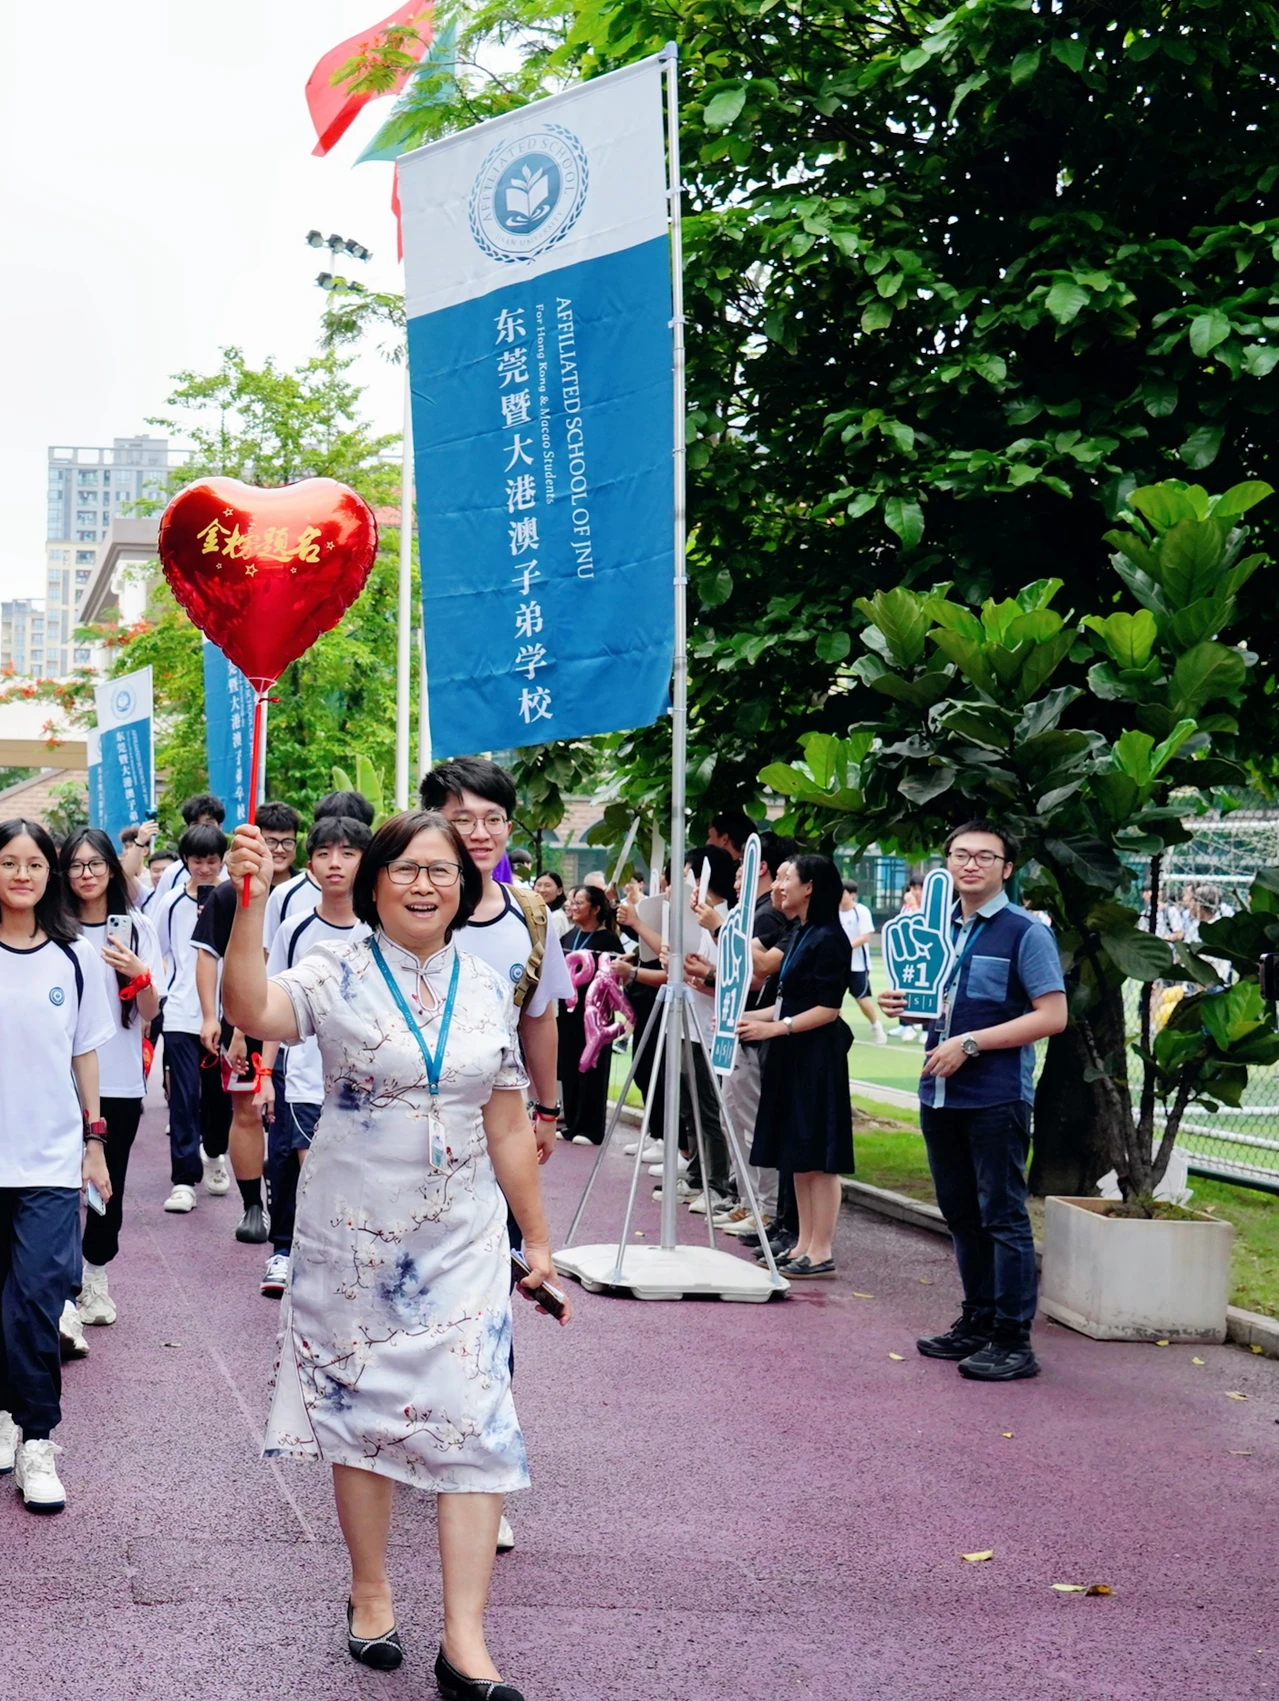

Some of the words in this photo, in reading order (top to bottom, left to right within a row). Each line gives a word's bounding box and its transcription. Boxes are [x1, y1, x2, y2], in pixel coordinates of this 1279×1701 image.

[481, 138, 537, 222] AFFILIATED
[542, 138, 577, 195] SCHOOL
[535, 303, 545, 324] For
[536, 326, 546, 359] Hong
[556, 297, 582, 414] AFFILIATED
[538, 361, 548, 393] Kong
[540, 395, 550, 406] &
[540, 408, 552, 449] Macao
[543, 451, 557, 505] Students
[566, 417, 589, 506] SCHOOL
[493, 307, 554, 724] 东莞暨大港澳子弟学校
[571, 508, 591, 537] OF
[197, 518, 322, 563] 金榜题名
[570, 541, 595, 579] JNU
[902, 962, 930, 988] #1
[721, 987, 737, 1028] #1
